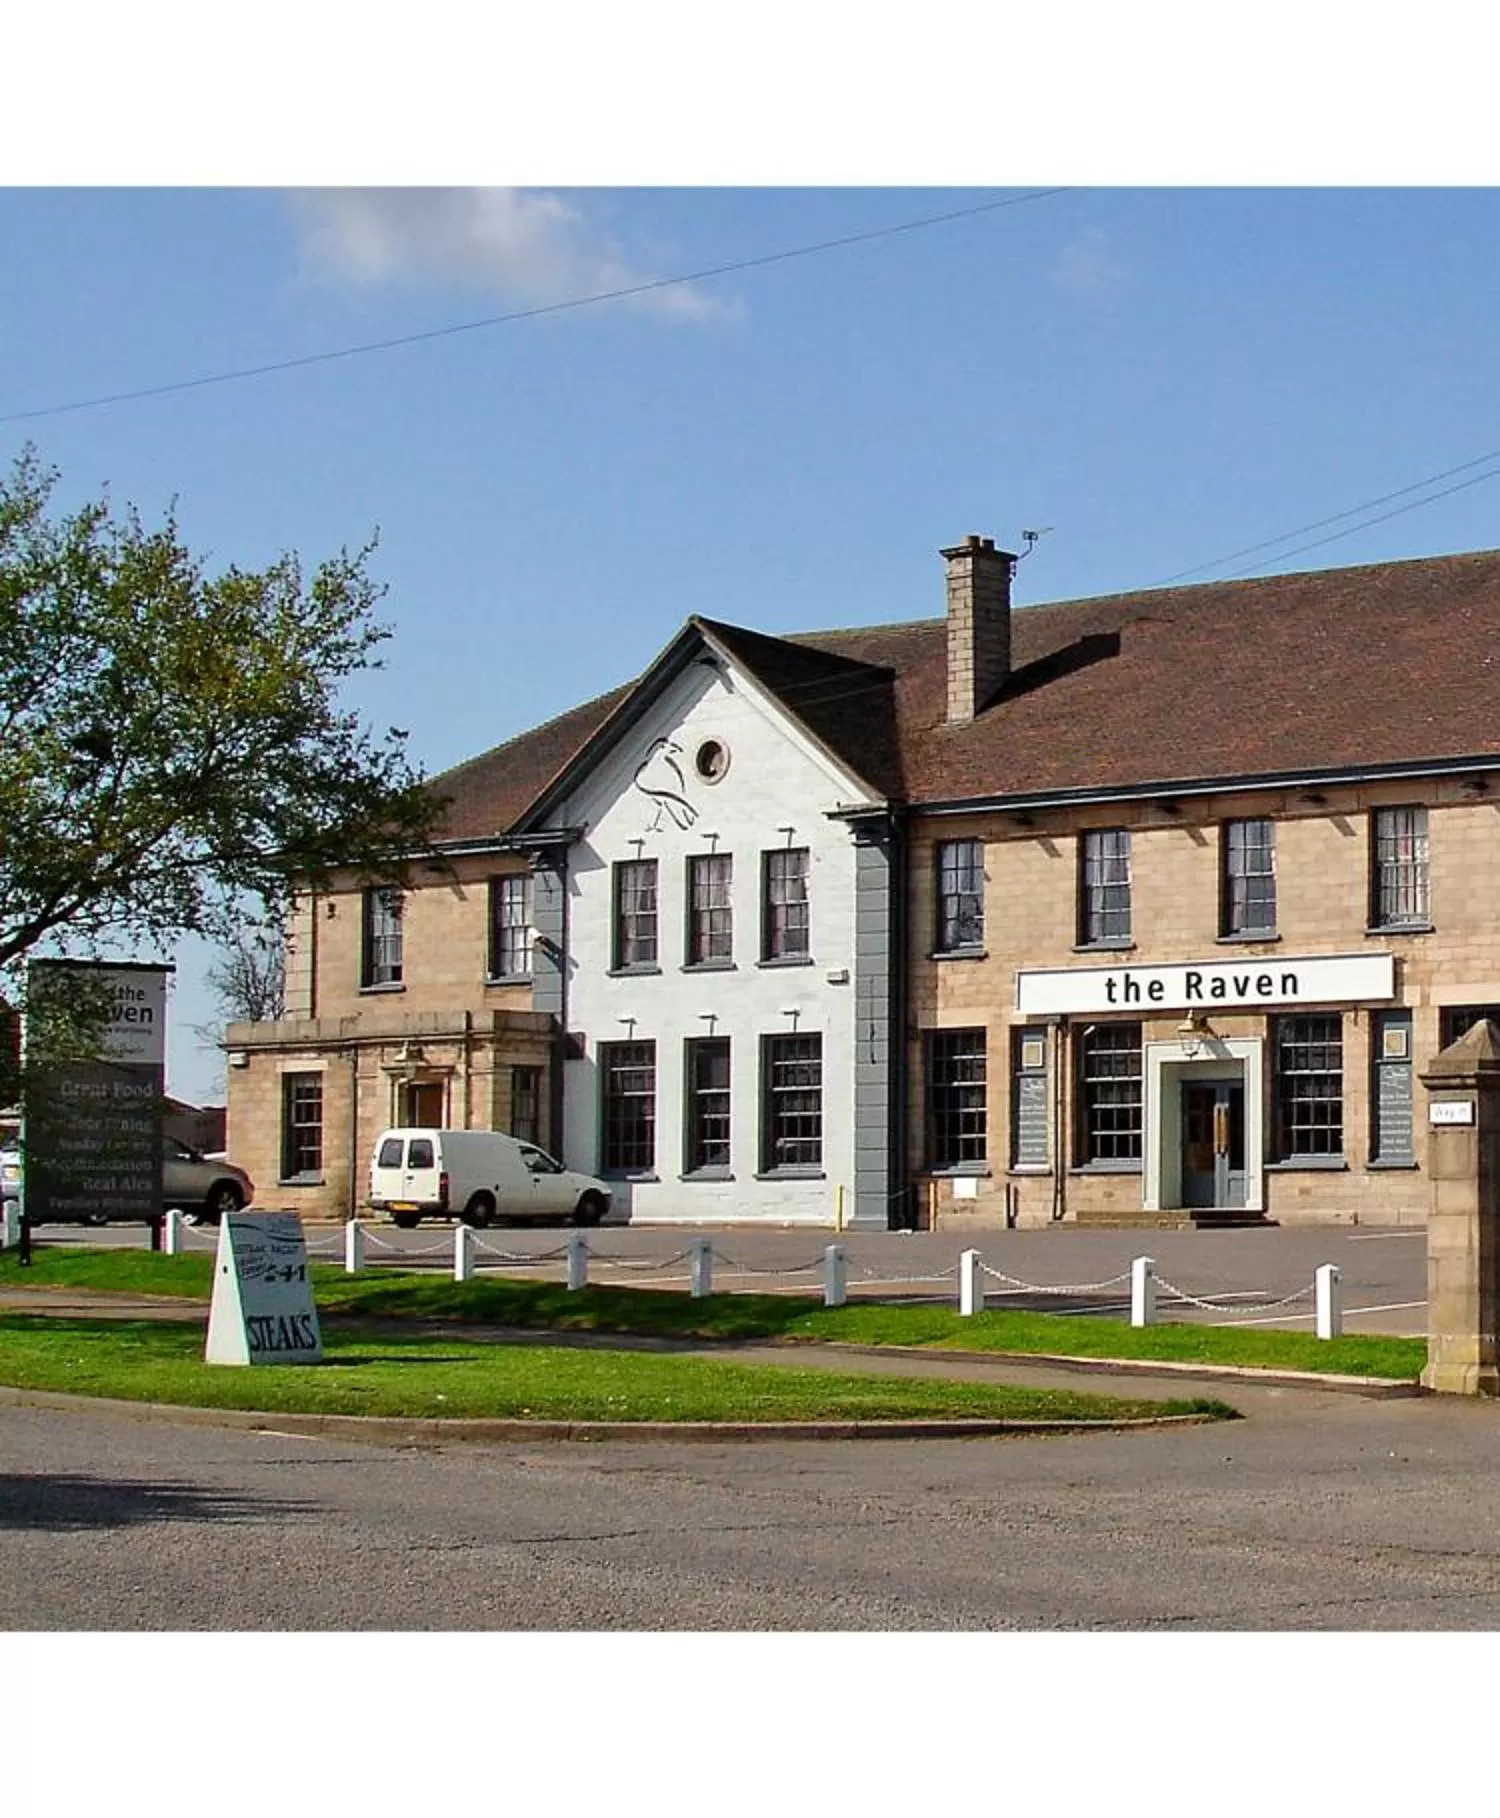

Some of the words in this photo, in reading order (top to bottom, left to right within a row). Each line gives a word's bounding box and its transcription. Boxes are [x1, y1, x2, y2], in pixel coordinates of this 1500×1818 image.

[1105, 973, 1165, 1004] the
[1185, 970, 1299, 1000] Raven
[247, 1314, 317, 1351] STEAKS
